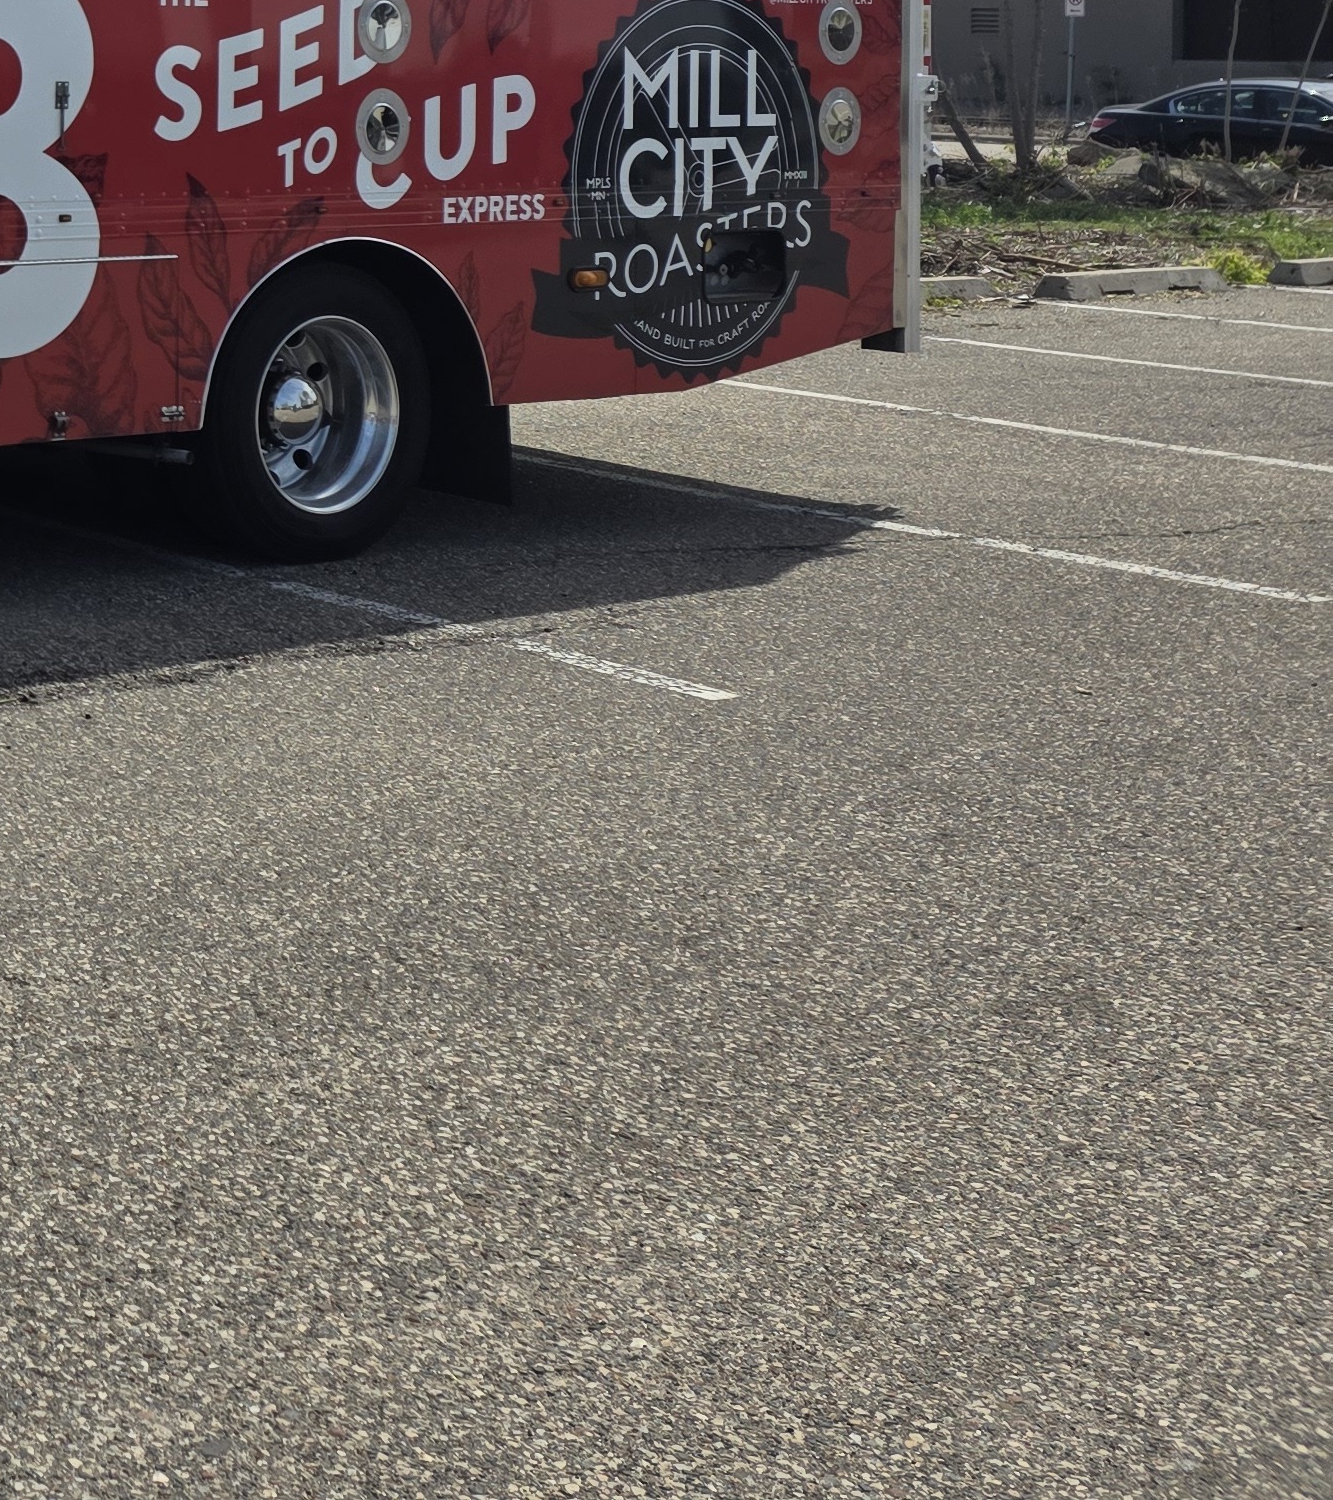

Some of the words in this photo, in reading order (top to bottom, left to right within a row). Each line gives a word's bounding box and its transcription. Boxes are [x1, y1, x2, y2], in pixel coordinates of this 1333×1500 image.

[623, 46, 776, 129] MILL
[277, 126, 337, 187] TO
[619, 136, 779, 218] CITY
[586, 177, 611, 189] MPLS
[443, 193, 545, 224] EXPRESS
[634, 320, 661, 340] AND
[664, 333, 696, 349] BUILT
[699, 338, 715, 348] FOR
[717, 319, 750, 345] CRAFT
